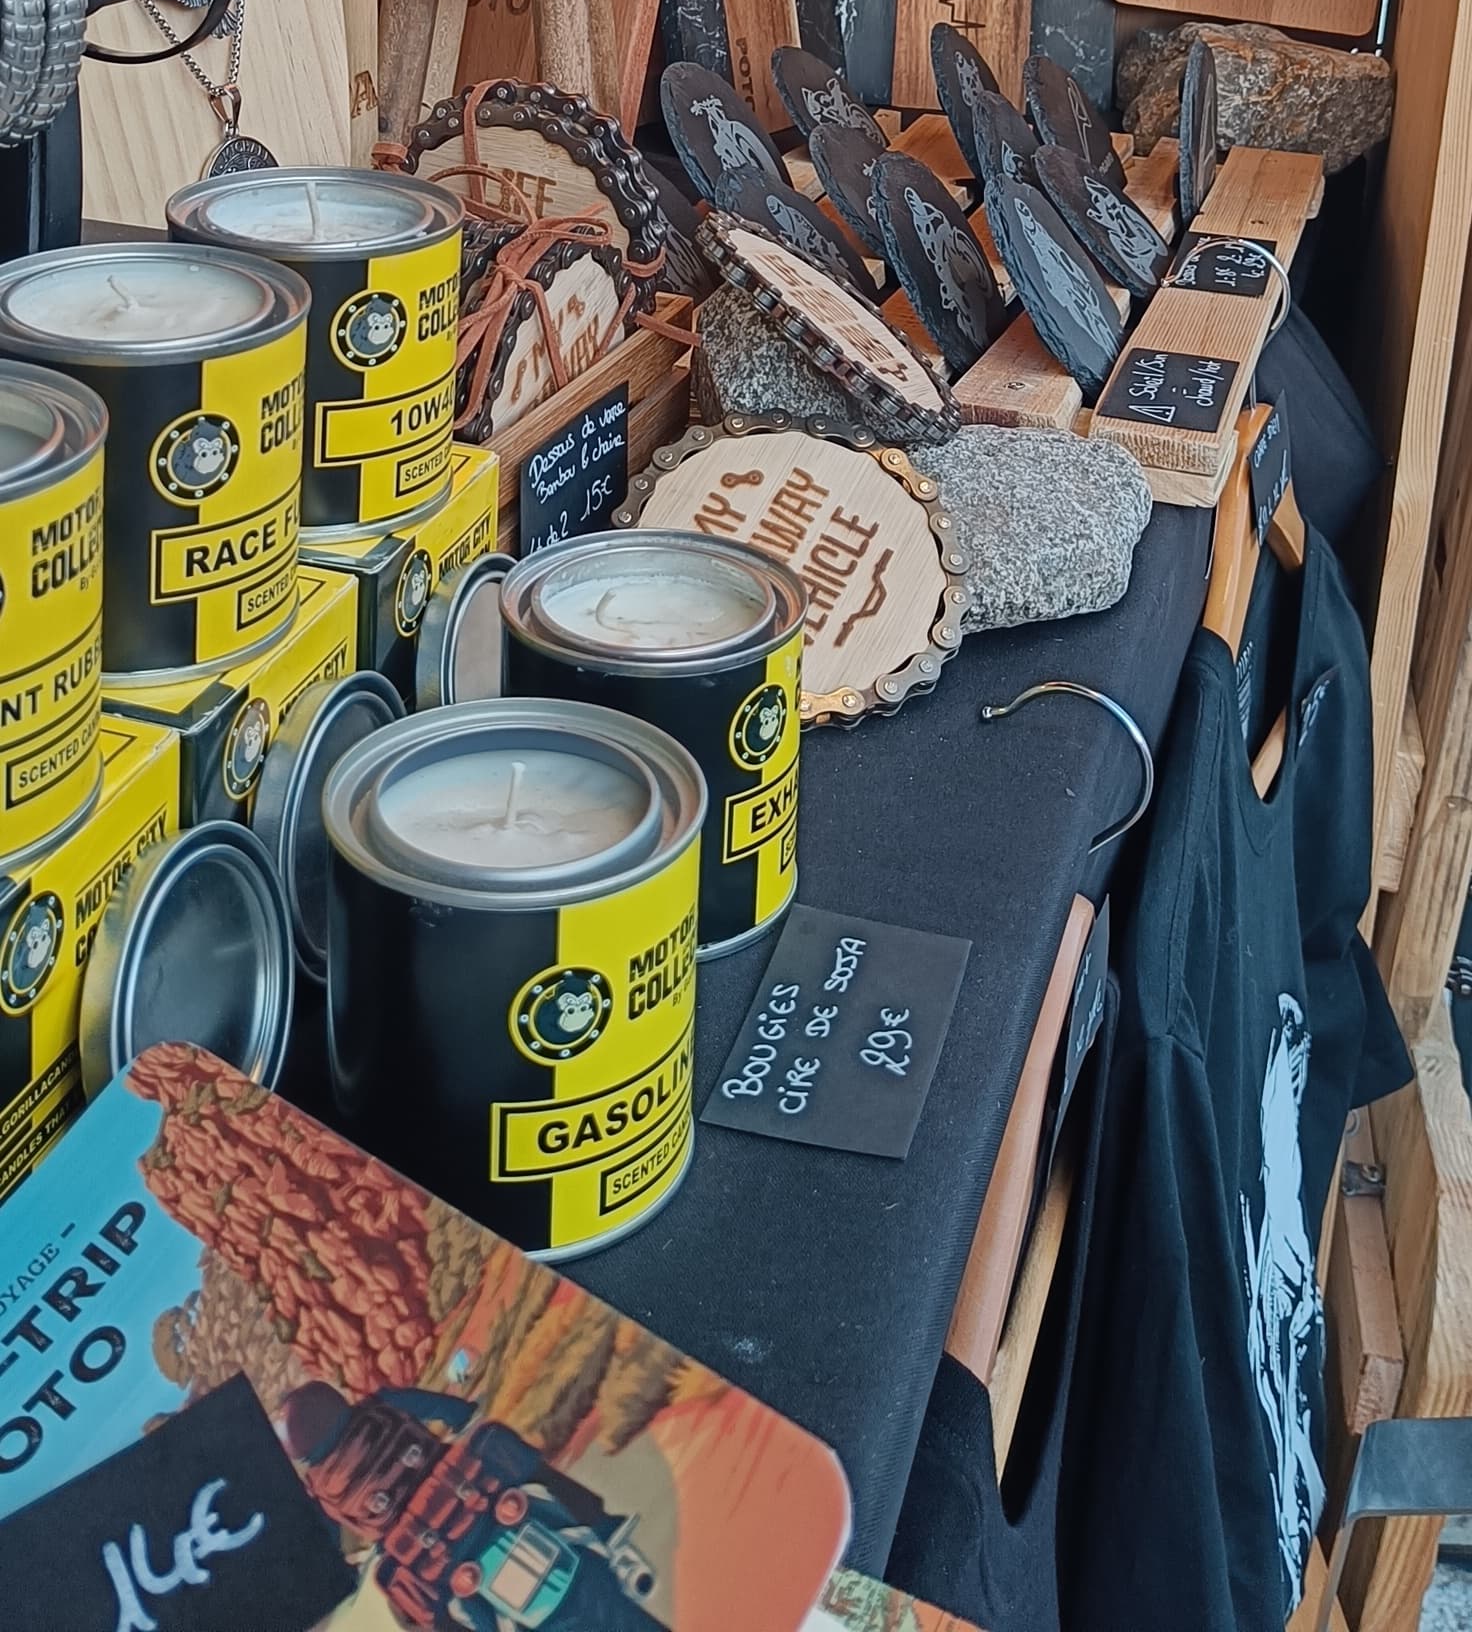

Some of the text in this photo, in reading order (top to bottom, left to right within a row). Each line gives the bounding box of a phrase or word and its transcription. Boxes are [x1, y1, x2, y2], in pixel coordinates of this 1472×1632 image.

[404, 451, 443, 483] SCENTED
[528, 432, 576, 489] Dessous
[581, 413, 597, 439] de
[580, 474, 614, 522] 15€
[185, 517, 278, 578] RACE
[559, 510, 569, 539] 2
[247, 573, 289, 613] SCENTED
[18, 737, 80, 789] SCENTED
[804, 1004, 839, 1038] DE
[859, 1007, 914, 1076] 29€
[612, 1143, 670, 1195] SCENTED
